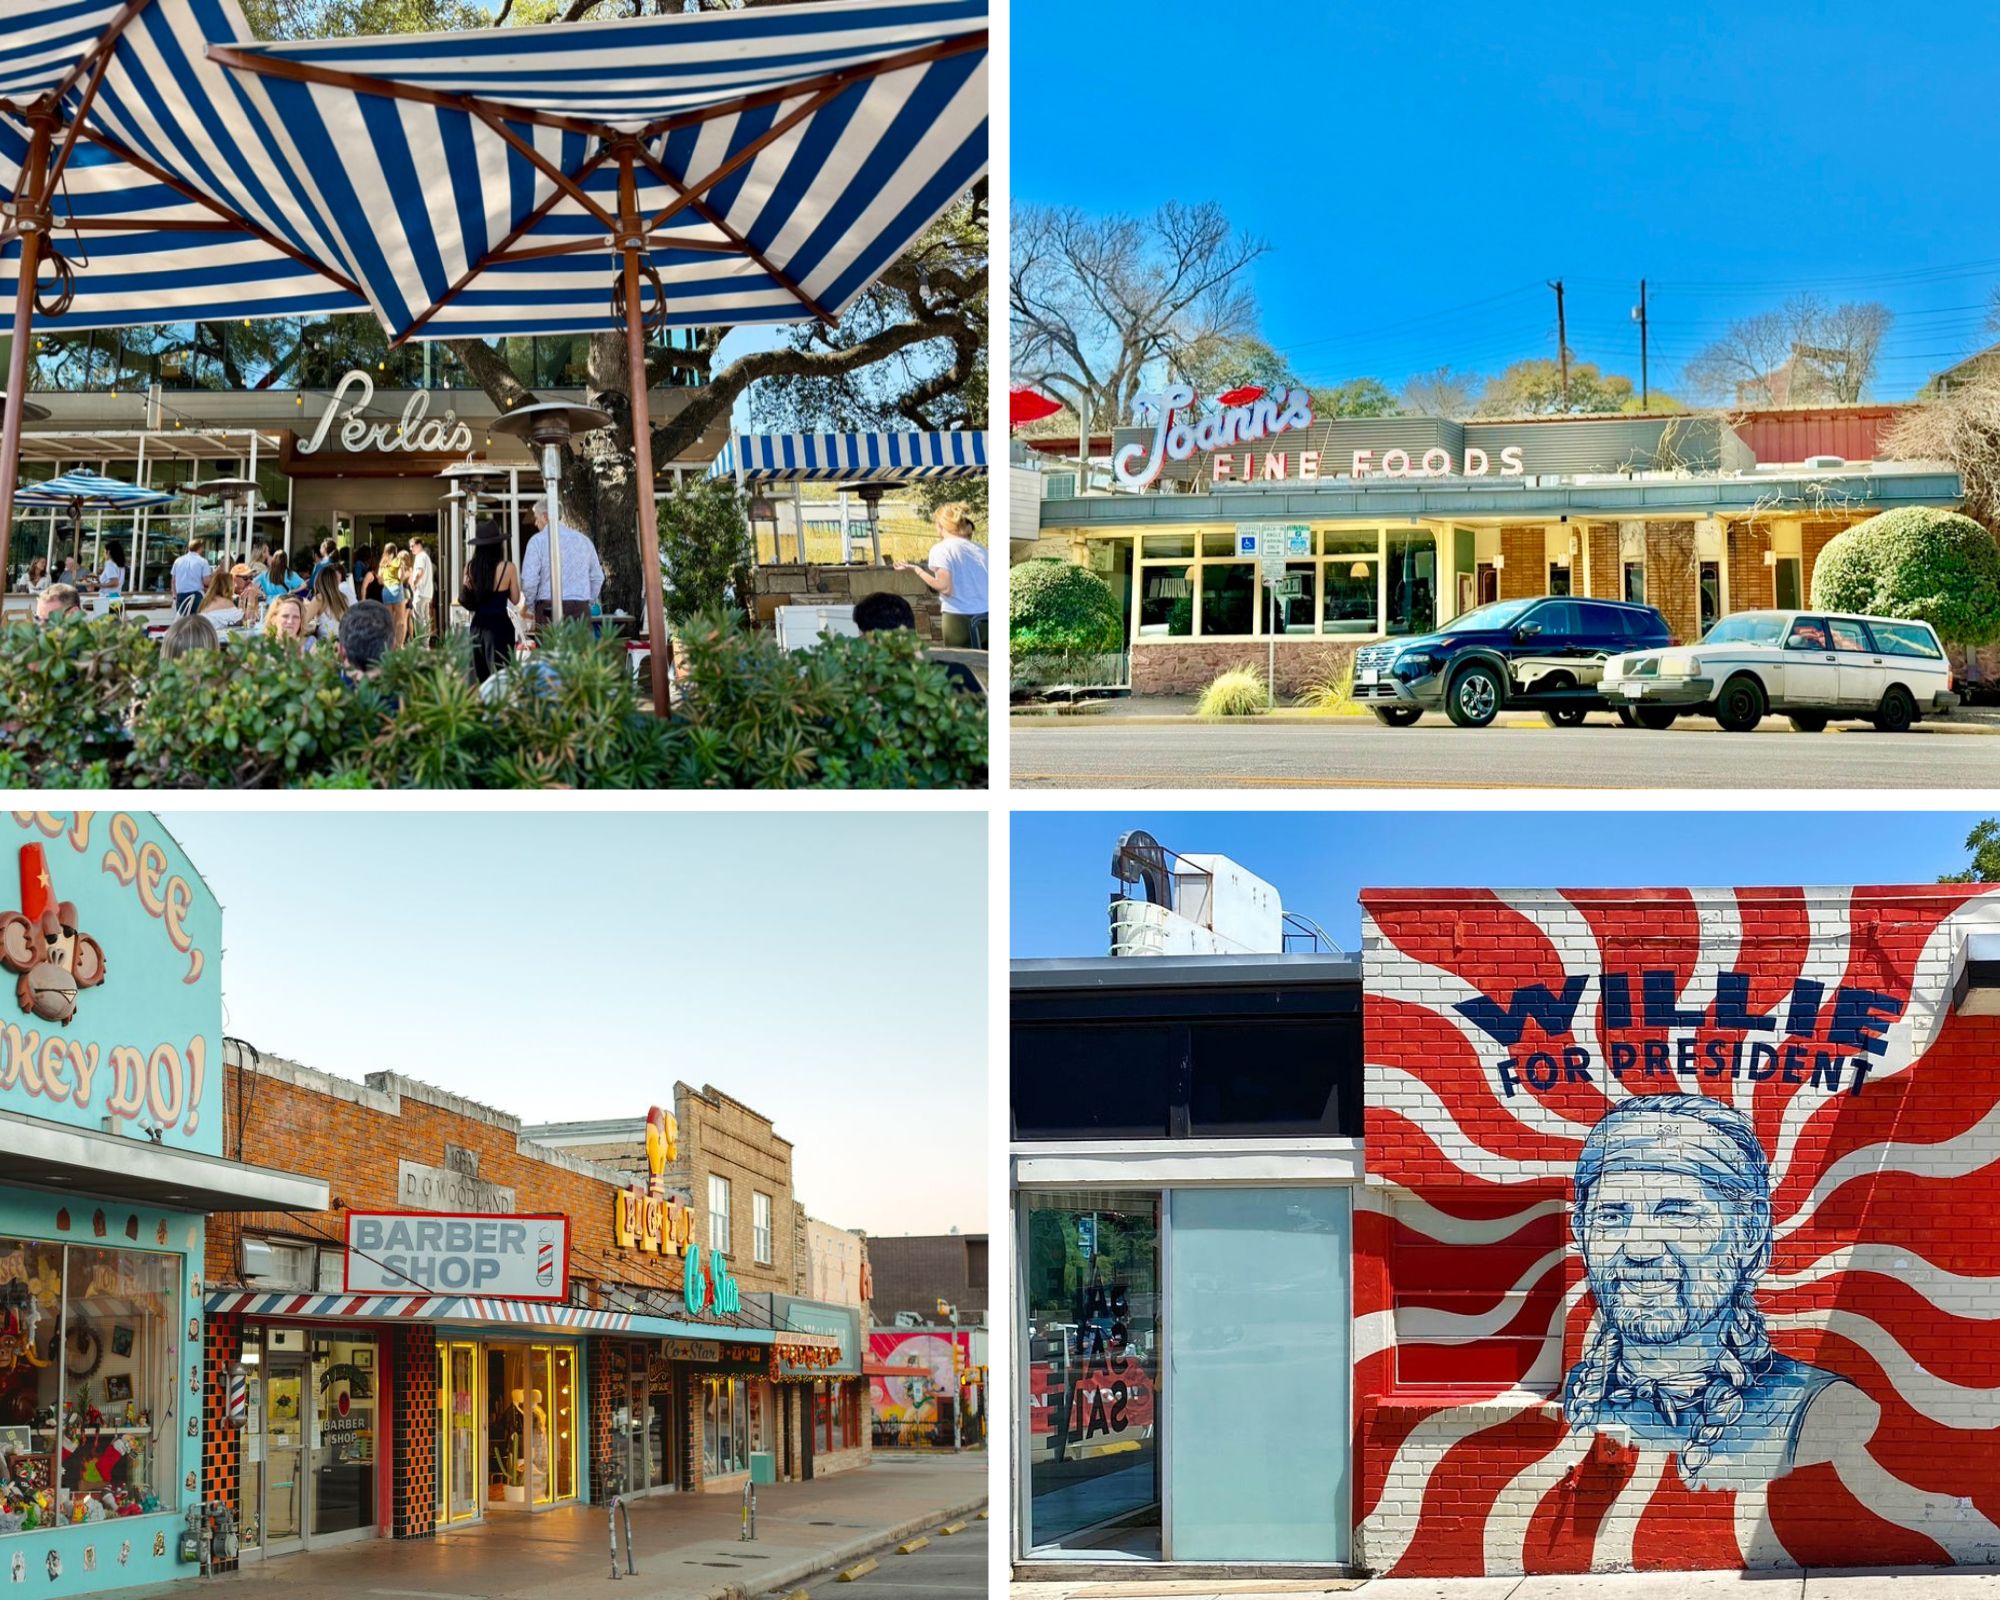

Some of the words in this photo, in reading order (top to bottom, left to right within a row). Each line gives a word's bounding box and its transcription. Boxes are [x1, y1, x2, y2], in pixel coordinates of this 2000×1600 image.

[297, 369, 473, 455] Perla's
[1113, 384, 1315, 487] Joann's
[1212, 450, 1322, 482] FINE
[1351, 446, 1524, 480] FOODS
[1452, 970, 1902, 1057] WILLIE
[106, 1033, 207, 1137] DO!
[1496, 1045, 1593, 1099] FOR
[1611, 1037, 1873, 1097] PRESIDENT
[356, 1219, 527, 1254] BARBER
[622, 1195, 657, 1239] BIG
[380, 1254, 500, 1289] SHOP
[664, 1341, 680, 1360] Co
[689, 1342, 718, 1361] Star
[323, 1418, 366, 1431] BARBER
[330, 1432, 359, 1445] SHOP
